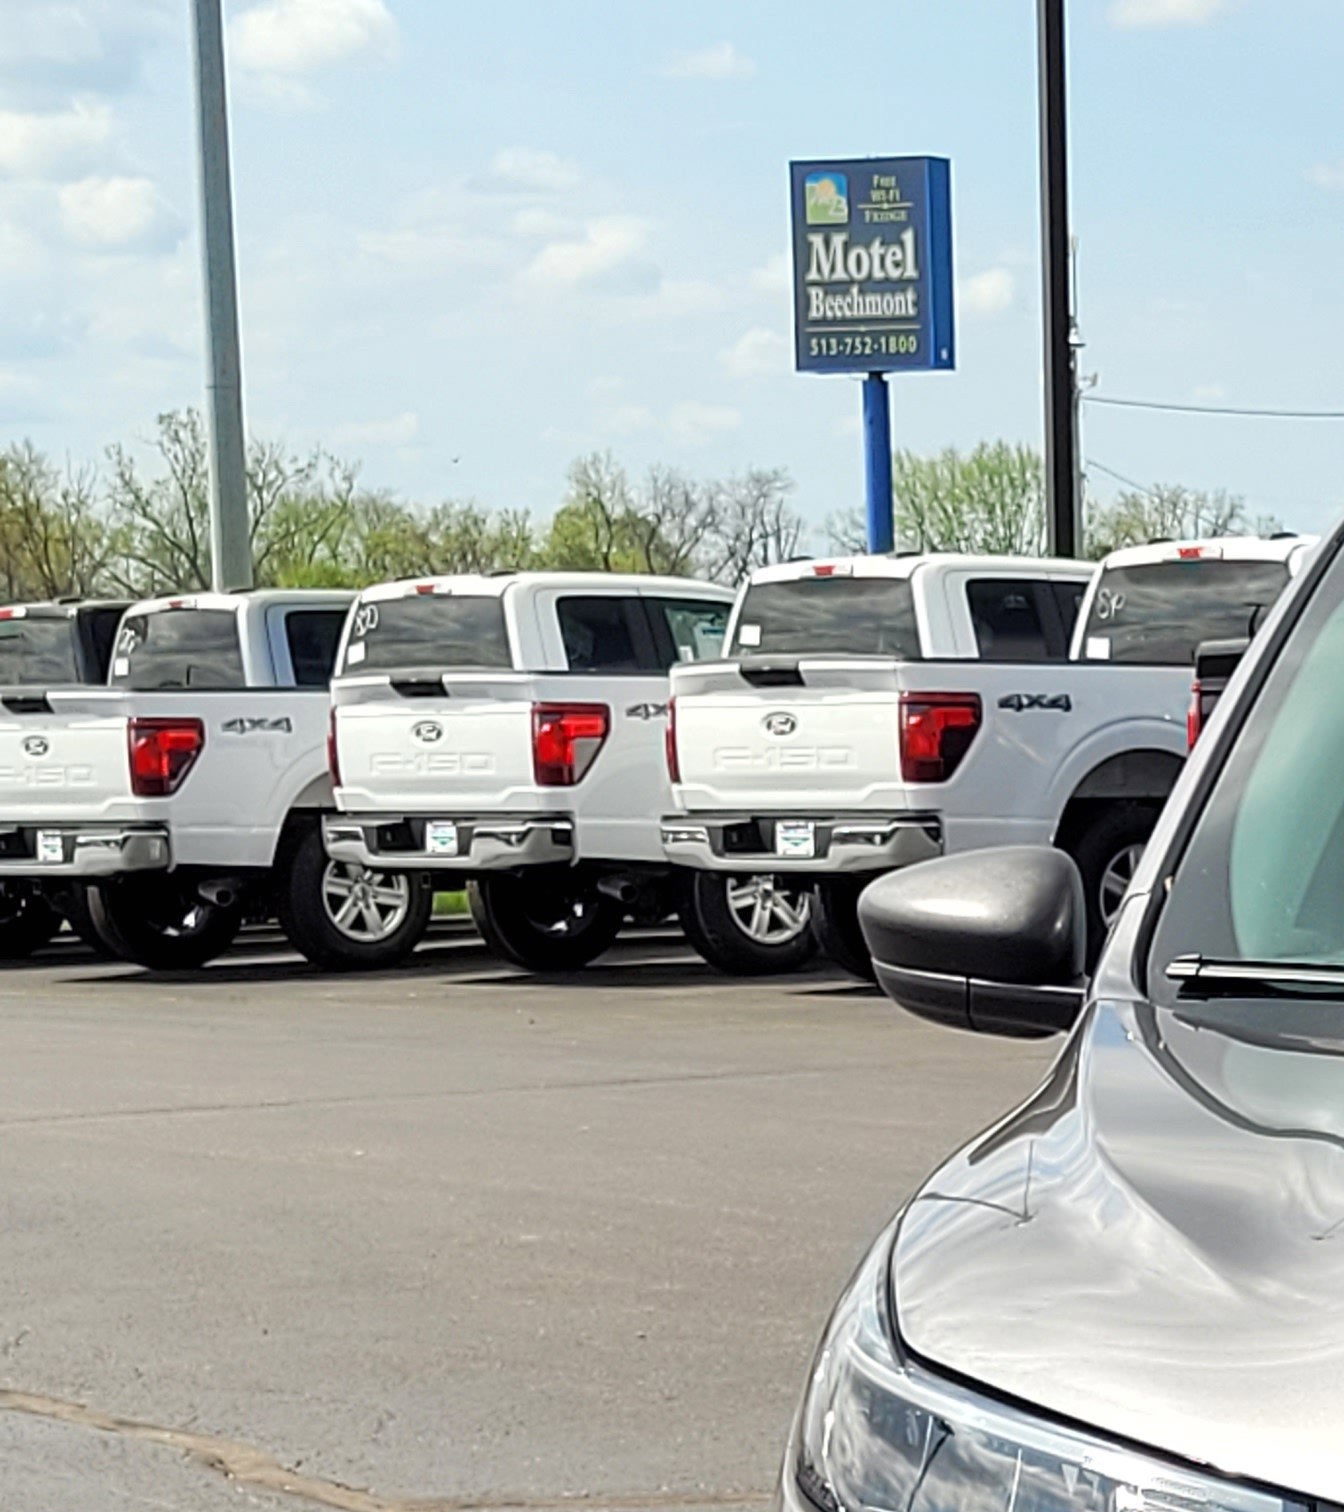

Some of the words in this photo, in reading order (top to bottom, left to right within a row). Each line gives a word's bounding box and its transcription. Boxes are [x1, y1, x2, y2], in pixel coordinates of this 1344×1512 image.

[805, 227, 919, 281] Motel
[807, 284, 917, 320] Beechmont
[626, 703, 668, 719] 4X
